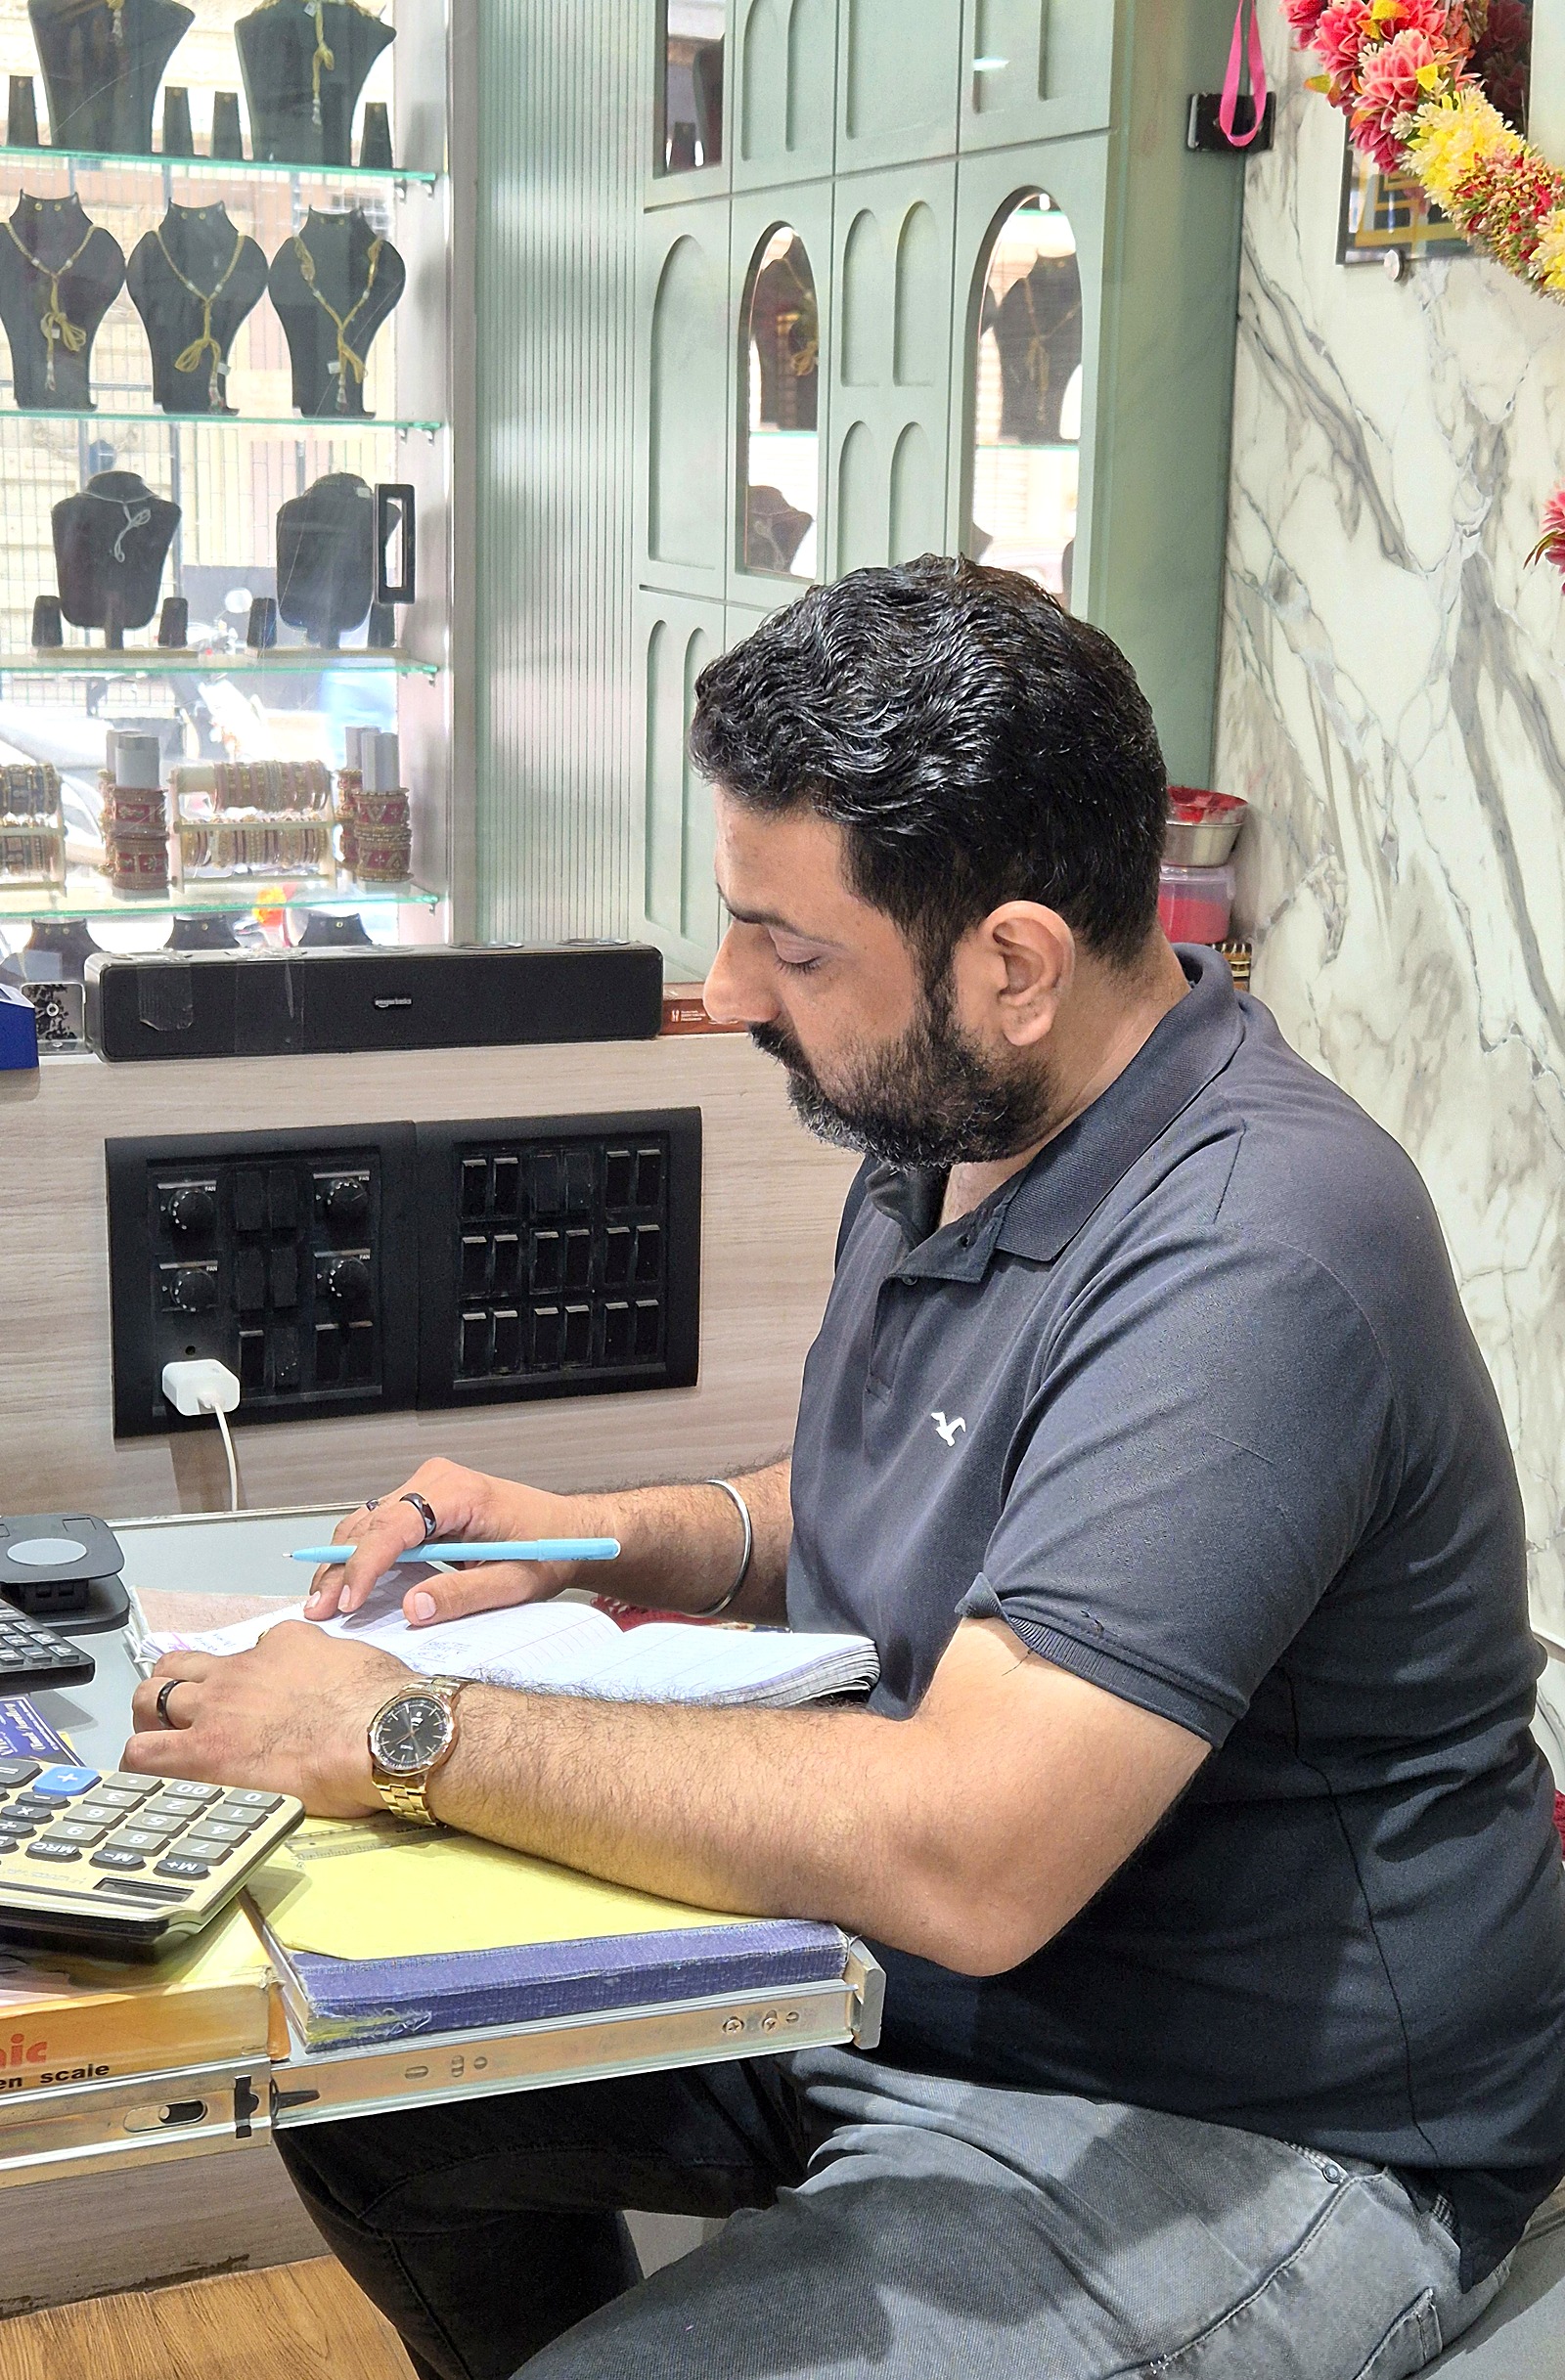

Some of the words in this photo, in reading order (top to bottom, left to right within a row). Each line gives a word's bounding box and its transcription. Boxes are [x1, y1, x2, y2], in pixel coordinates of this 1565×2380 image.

[175, 1783, 210, 1795] 00
[106, 1791, 126, 1802] 3
[244, 1792, 262, 1802] 0
[165, 1800, 187, 1810] 2
[85, 1808, 106, 1818] 6
[230, 1808, 244, 1819] 1
[147, 1816, 168, 1827] 5
[67, 1826, 86, 1835] 9
[210, 1825, 231, 1835] 4
[128, 1833, 149, 1844] 8
[31, 1842, 78, 1854] MRC
[191, 1843, 210, 1854] 7
[104, 1852, 135, 1863] M-
[166, 1861, 199, 1872] M+
[0, 2033, 47, 2069] ic
[40, 2063, 110, 2084] scale
